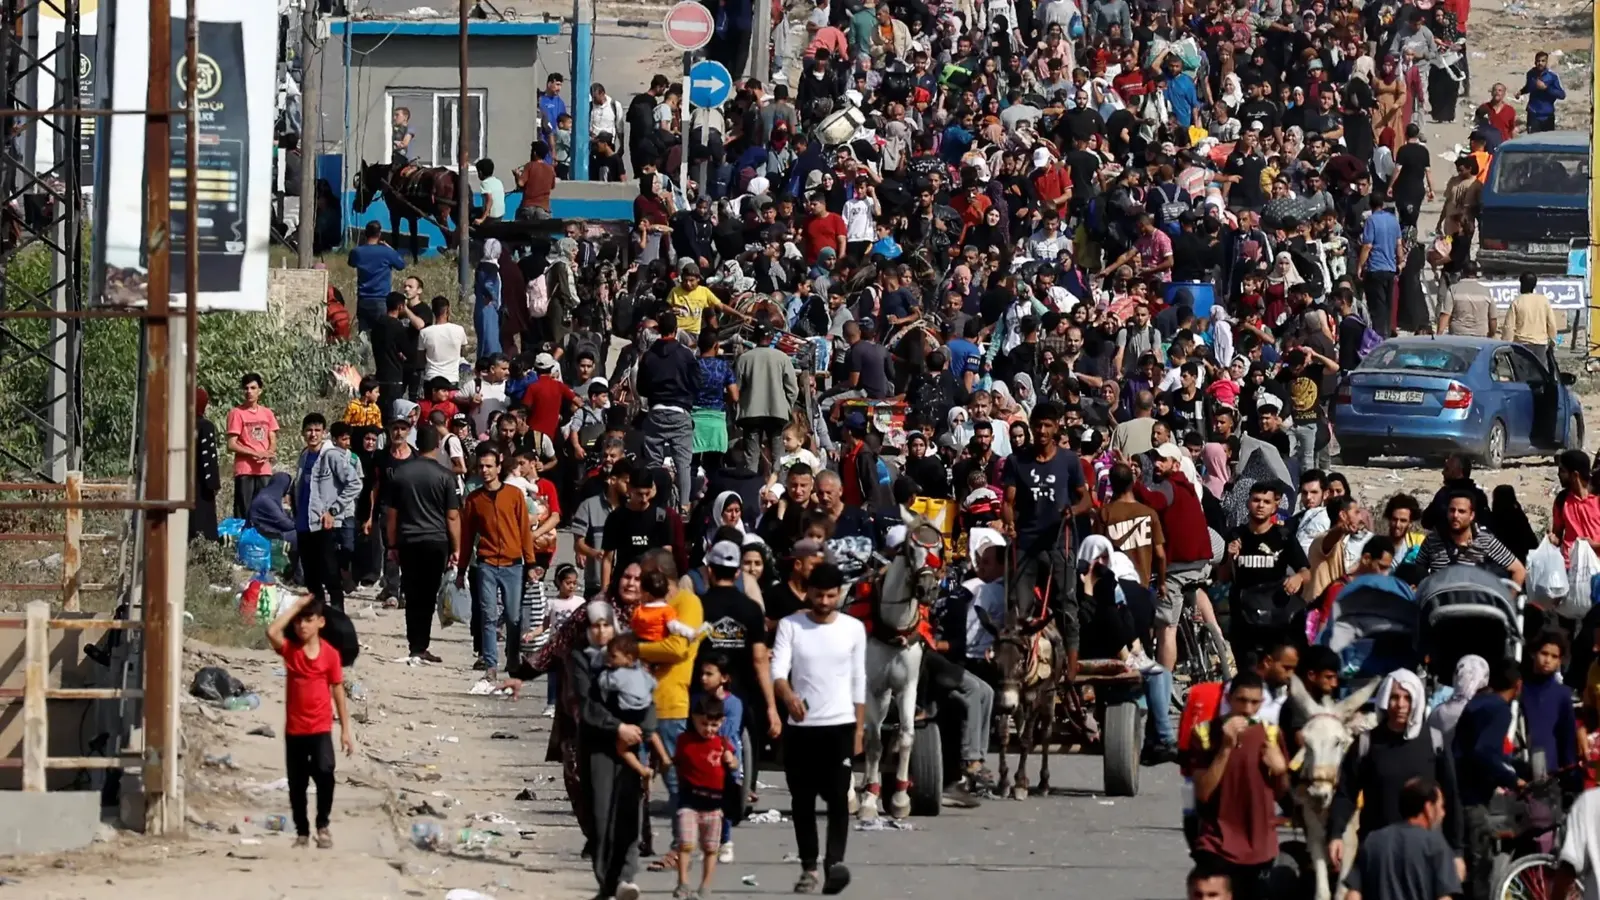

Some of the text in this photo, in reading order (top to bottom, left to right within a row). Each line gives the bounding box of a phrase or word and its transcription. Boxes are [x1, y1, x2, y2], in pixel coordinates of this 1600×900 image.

[1489, 287, 1518, 302] LICE
[1107, 515, 1151, 551] NIKE
[1238, 555, 1276, 569] PUMA
